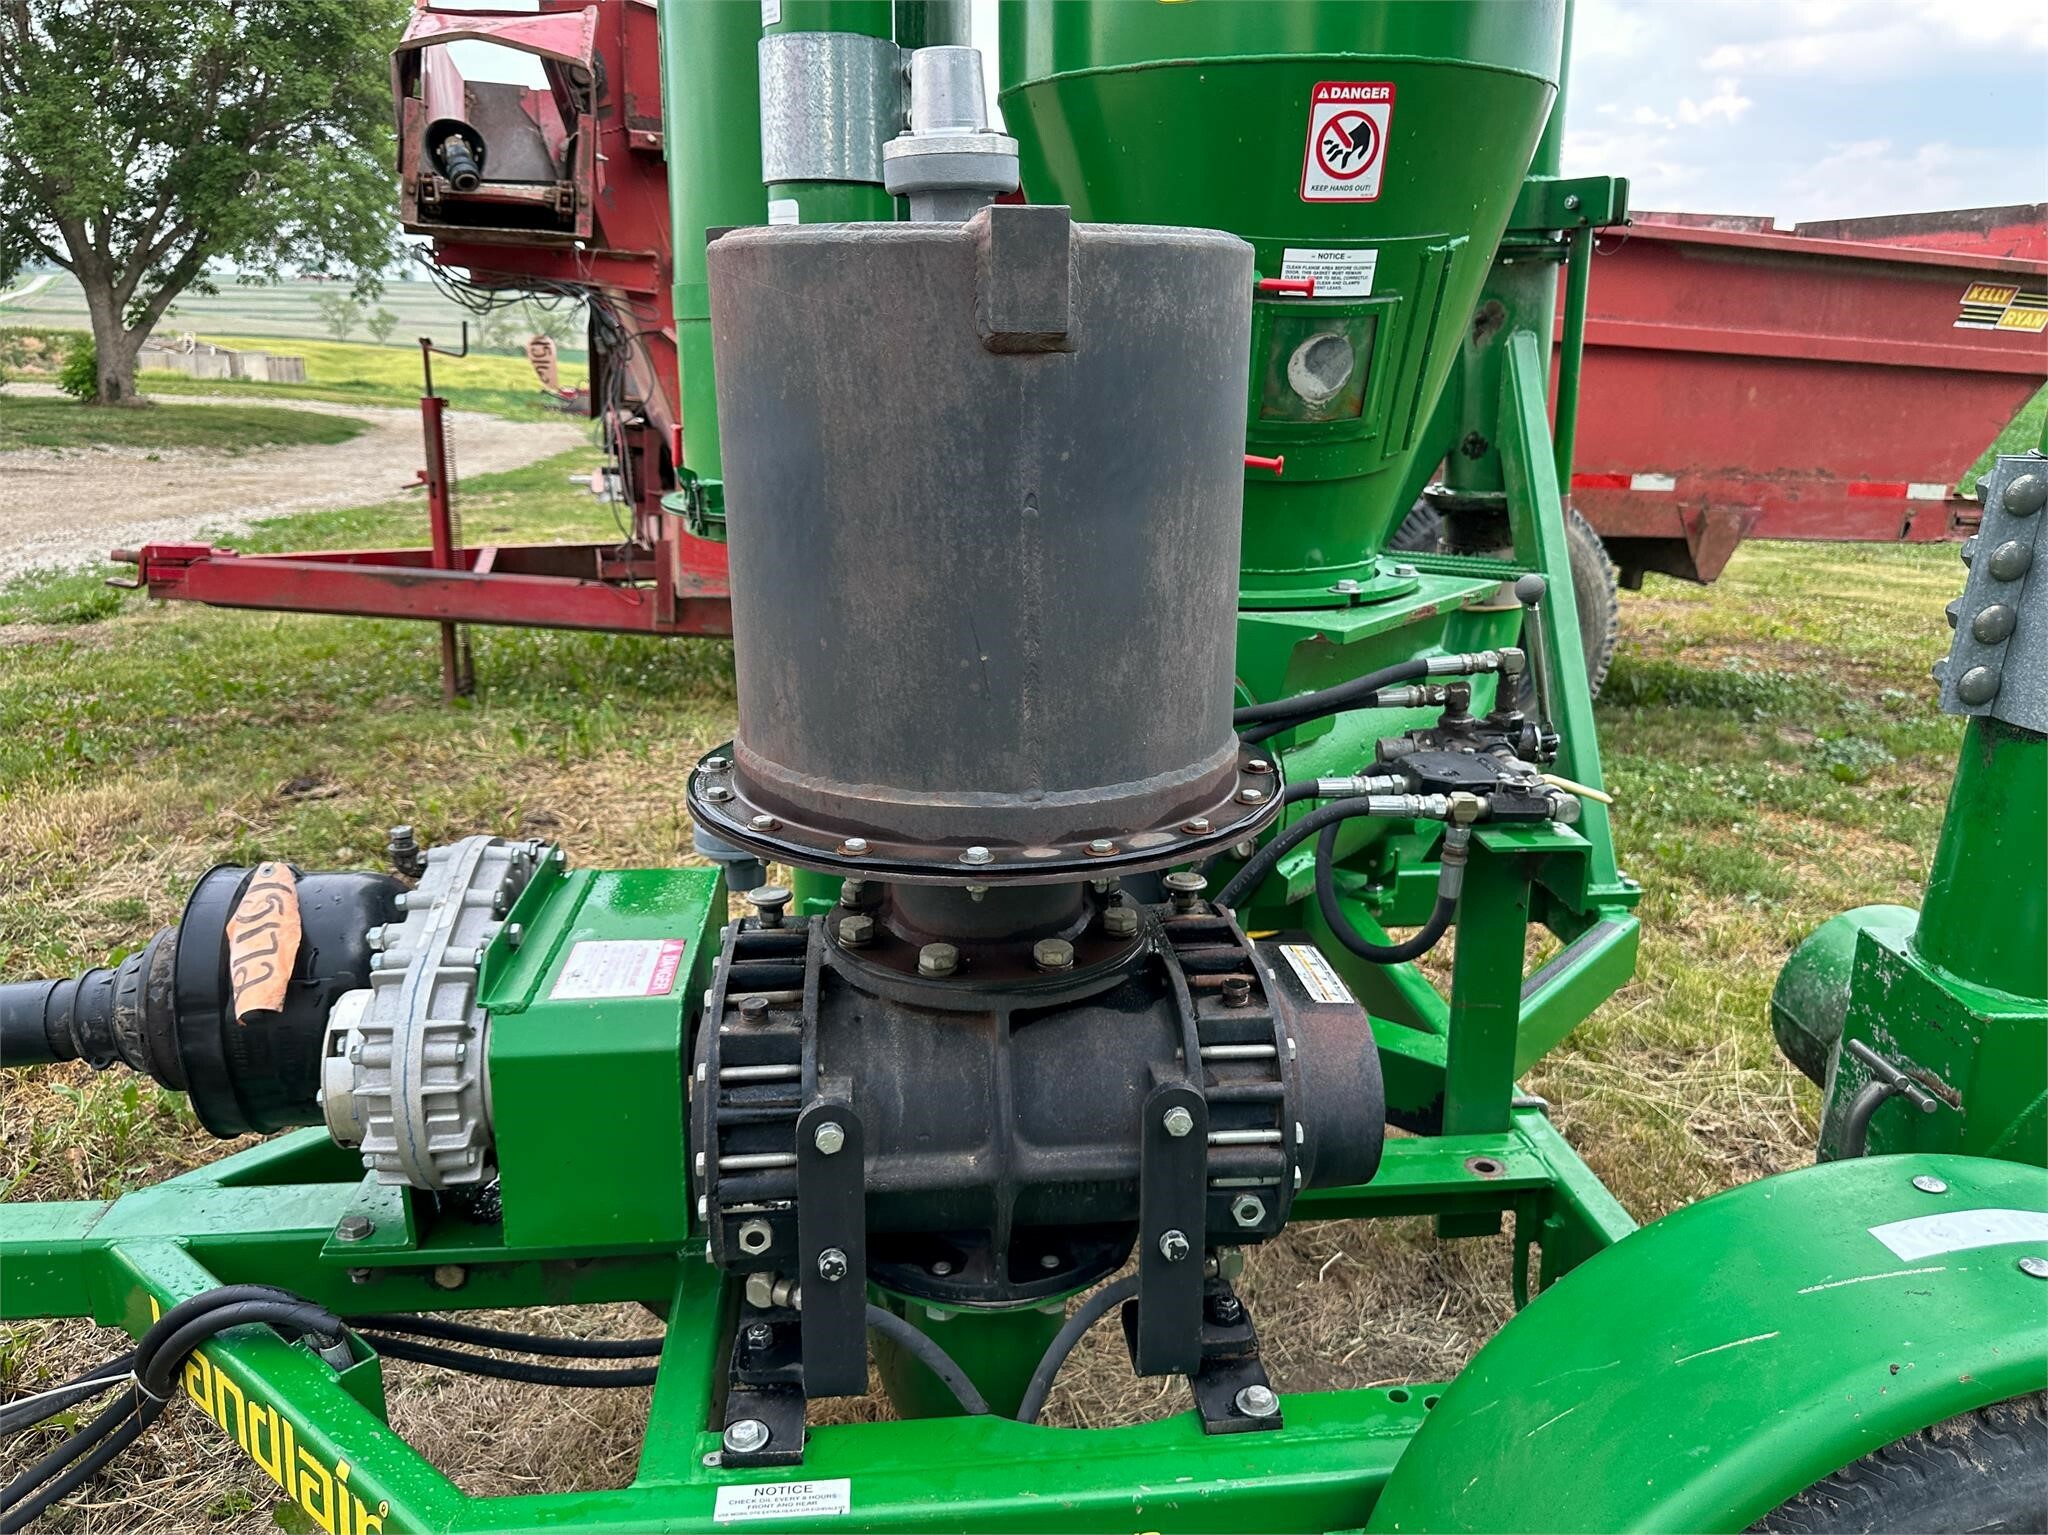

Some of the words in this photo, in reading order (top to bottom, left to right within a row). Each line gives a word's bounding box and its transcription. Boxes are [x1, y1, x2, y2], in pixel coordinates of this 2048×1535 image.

[1330, 87, 1390, 99] DANGER
[1968, 286, 2014, 303] KELLY
[2003, 310, 2047, 327] RYAN
[651, 955, 679, 991] DANGER
[149, 1294, 383, 1535] andlair
[754, 1484, 813, 1496] NOTICE
[728, 1498, 757, 1506] CHECK
[774, 1495, 800, 1503] EVERY
